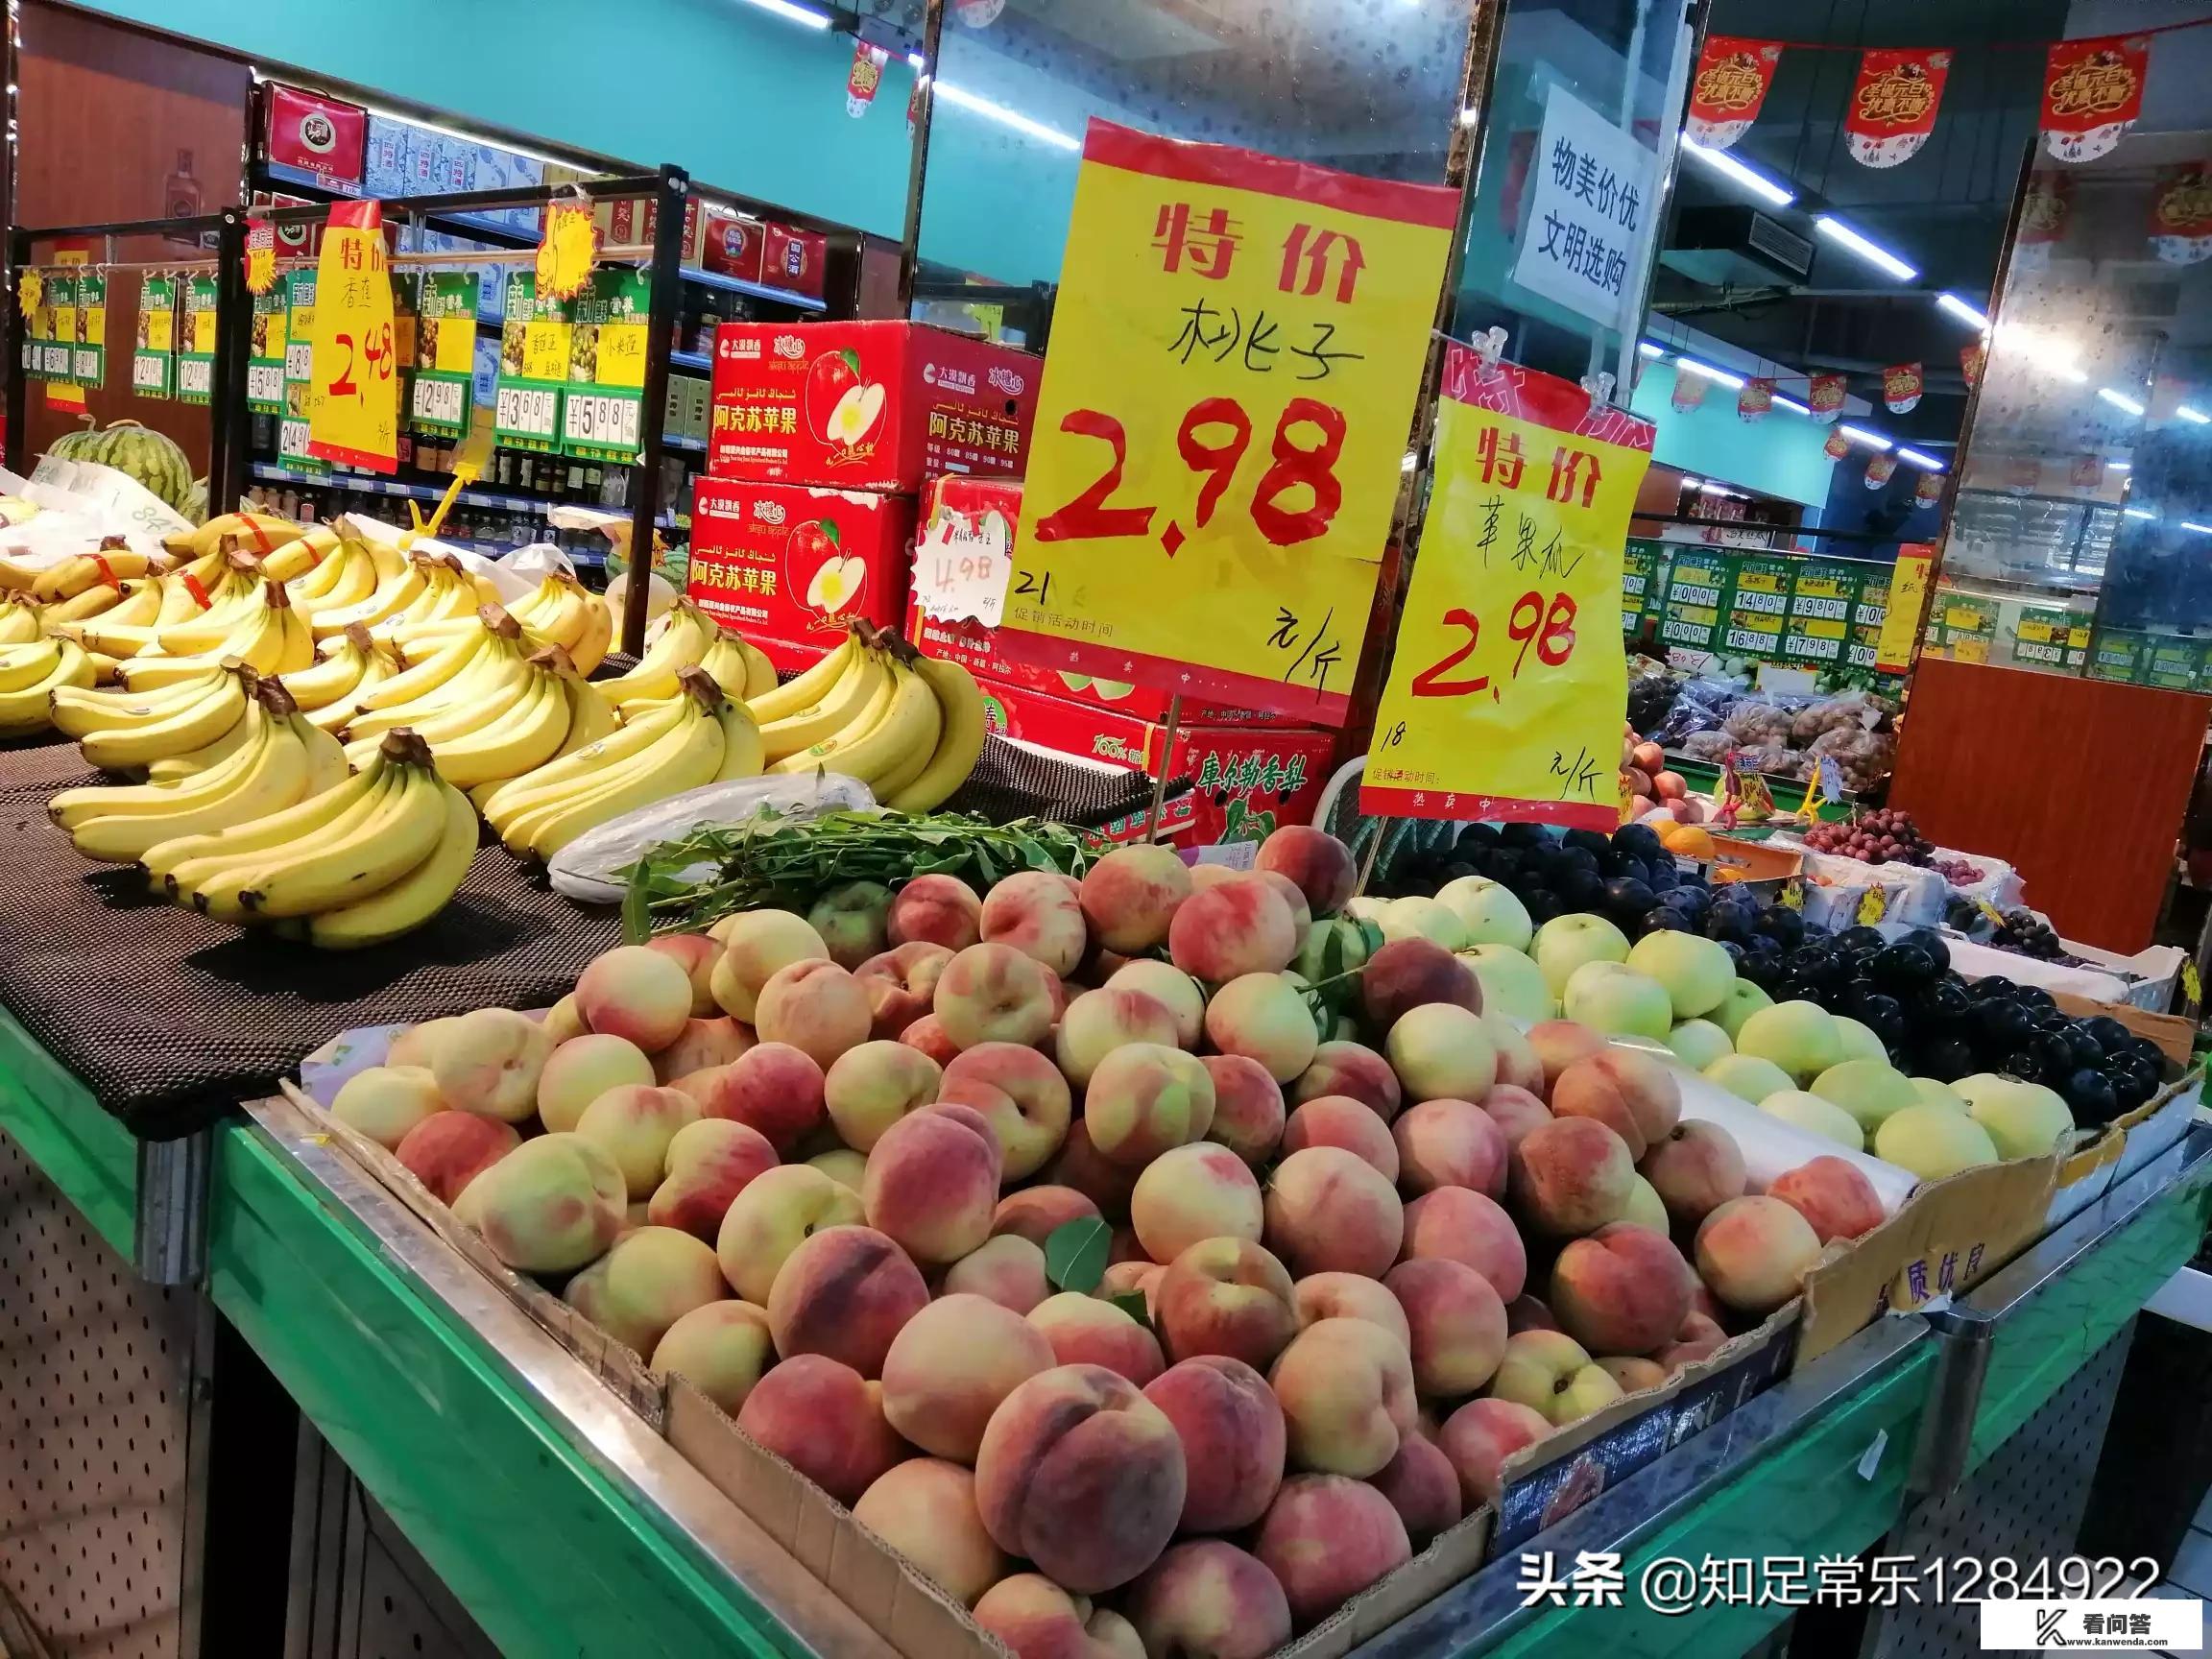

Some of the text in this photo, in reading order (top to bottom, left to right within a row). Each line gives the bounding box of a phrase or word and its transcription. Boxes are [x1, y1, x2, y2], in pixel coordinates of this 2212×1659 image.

[1552, 136, 1640, 232] 物美价优
[1152, 203, 1367, 304] 特价
[1538, 209, 1627, 296] 文明选购
[1167, 298, 1365, 380] 桃子
[713, 404, 797, 435] 阿克苏苹果
[928, 411, 1021, 454] 阿克苏苹果
[1034, 397, 1348, 559] 2.98
[1475, 426, 1603, 509] 特价
[690, 558, 777, 596] 阿克苏苹果
[1014, 571, 1050, 606] 21
[1014, 607, 1114, 637] 促销活动时间
[1411, 590, 1578, 706] 2.98
